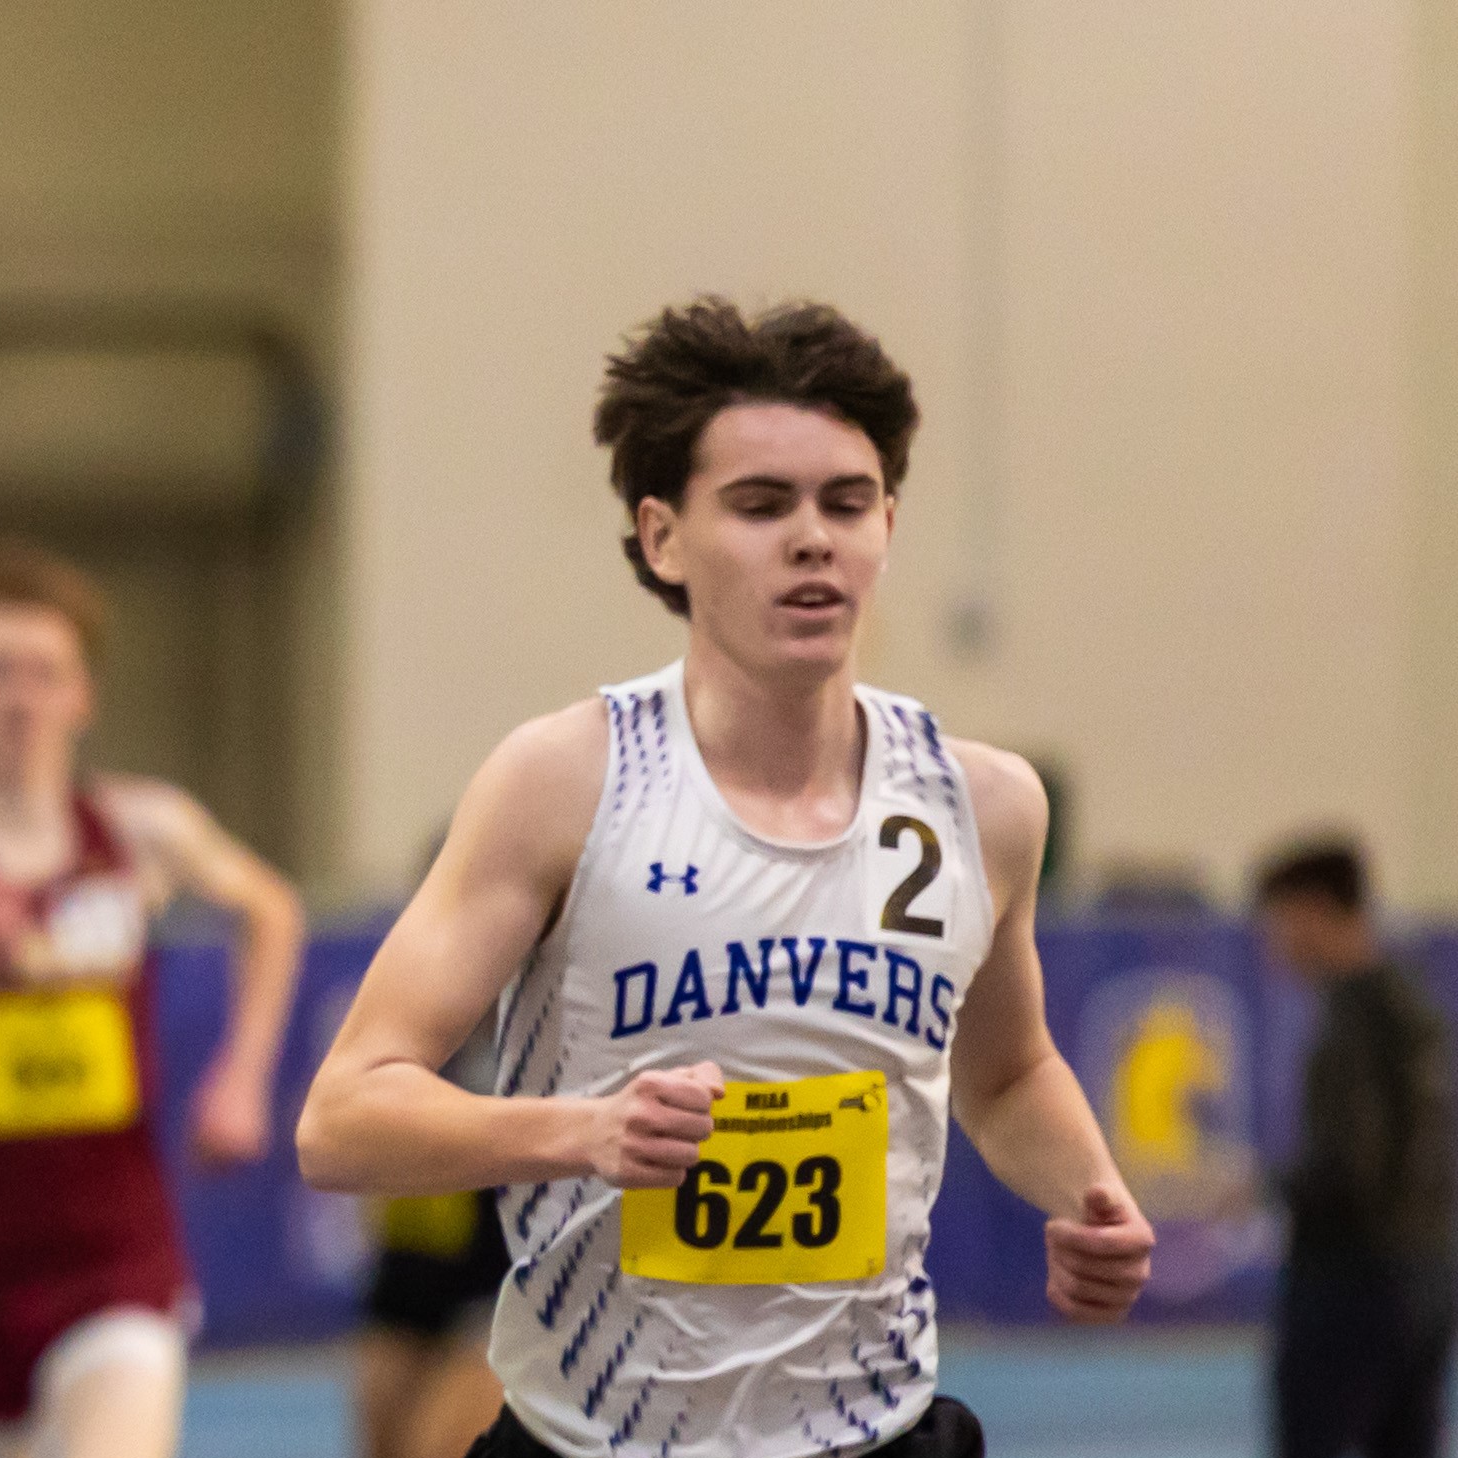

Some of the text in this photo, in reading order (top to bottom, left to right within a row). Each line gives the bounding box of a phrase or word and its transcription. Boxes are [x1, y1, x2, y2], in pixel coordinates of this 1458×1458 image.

[879, 815, 944, 938] 2
[610, 936, 955, 1052] DANVERS
[713, 1111, 832, 1135] ampionships
[673, 1155, 842, 1250] 623
